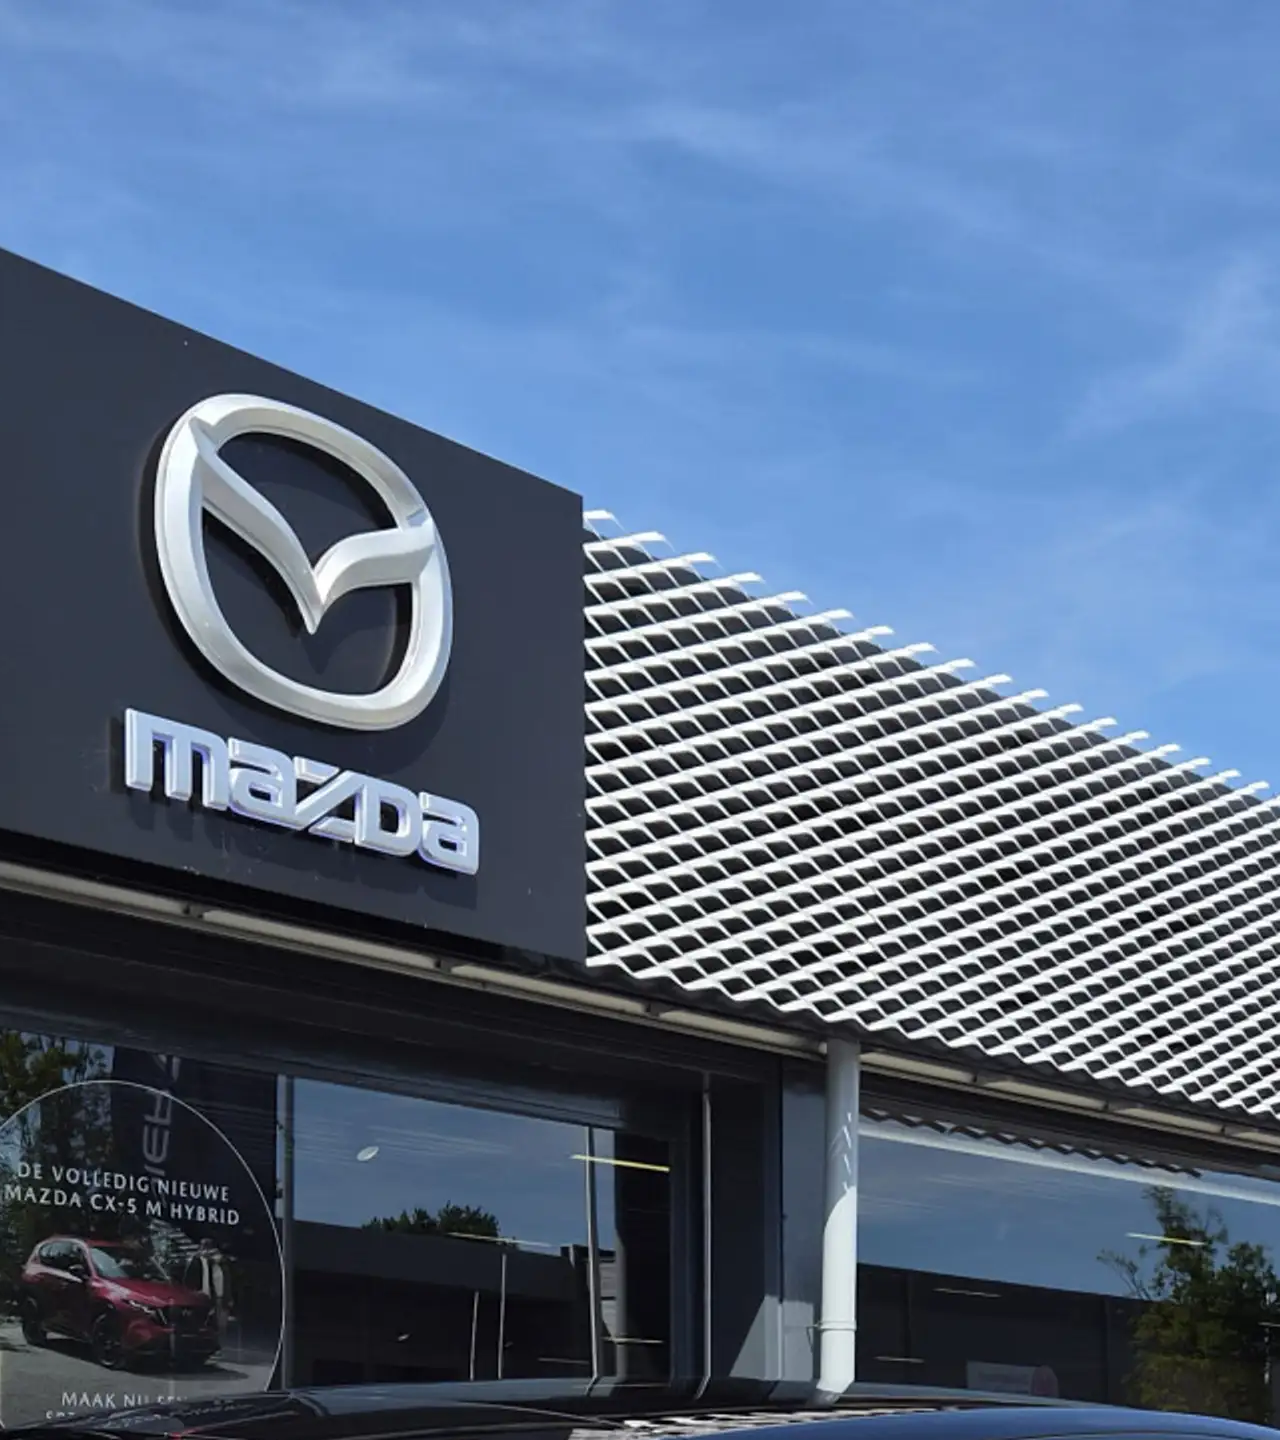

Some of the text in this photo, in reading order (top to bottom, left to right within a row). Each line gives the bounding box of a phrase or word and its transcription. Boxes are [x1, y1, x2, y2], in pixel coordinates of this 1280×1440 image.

[124, 708, 480, 875] mazda
[19, 1162, 230, 1202] DE VOLLEDIG NIEUWE
[4, 1184, 240, 1226] MAZDA CX-5 M HYBRID
[61, 1391, 117, 1410] MAAK
